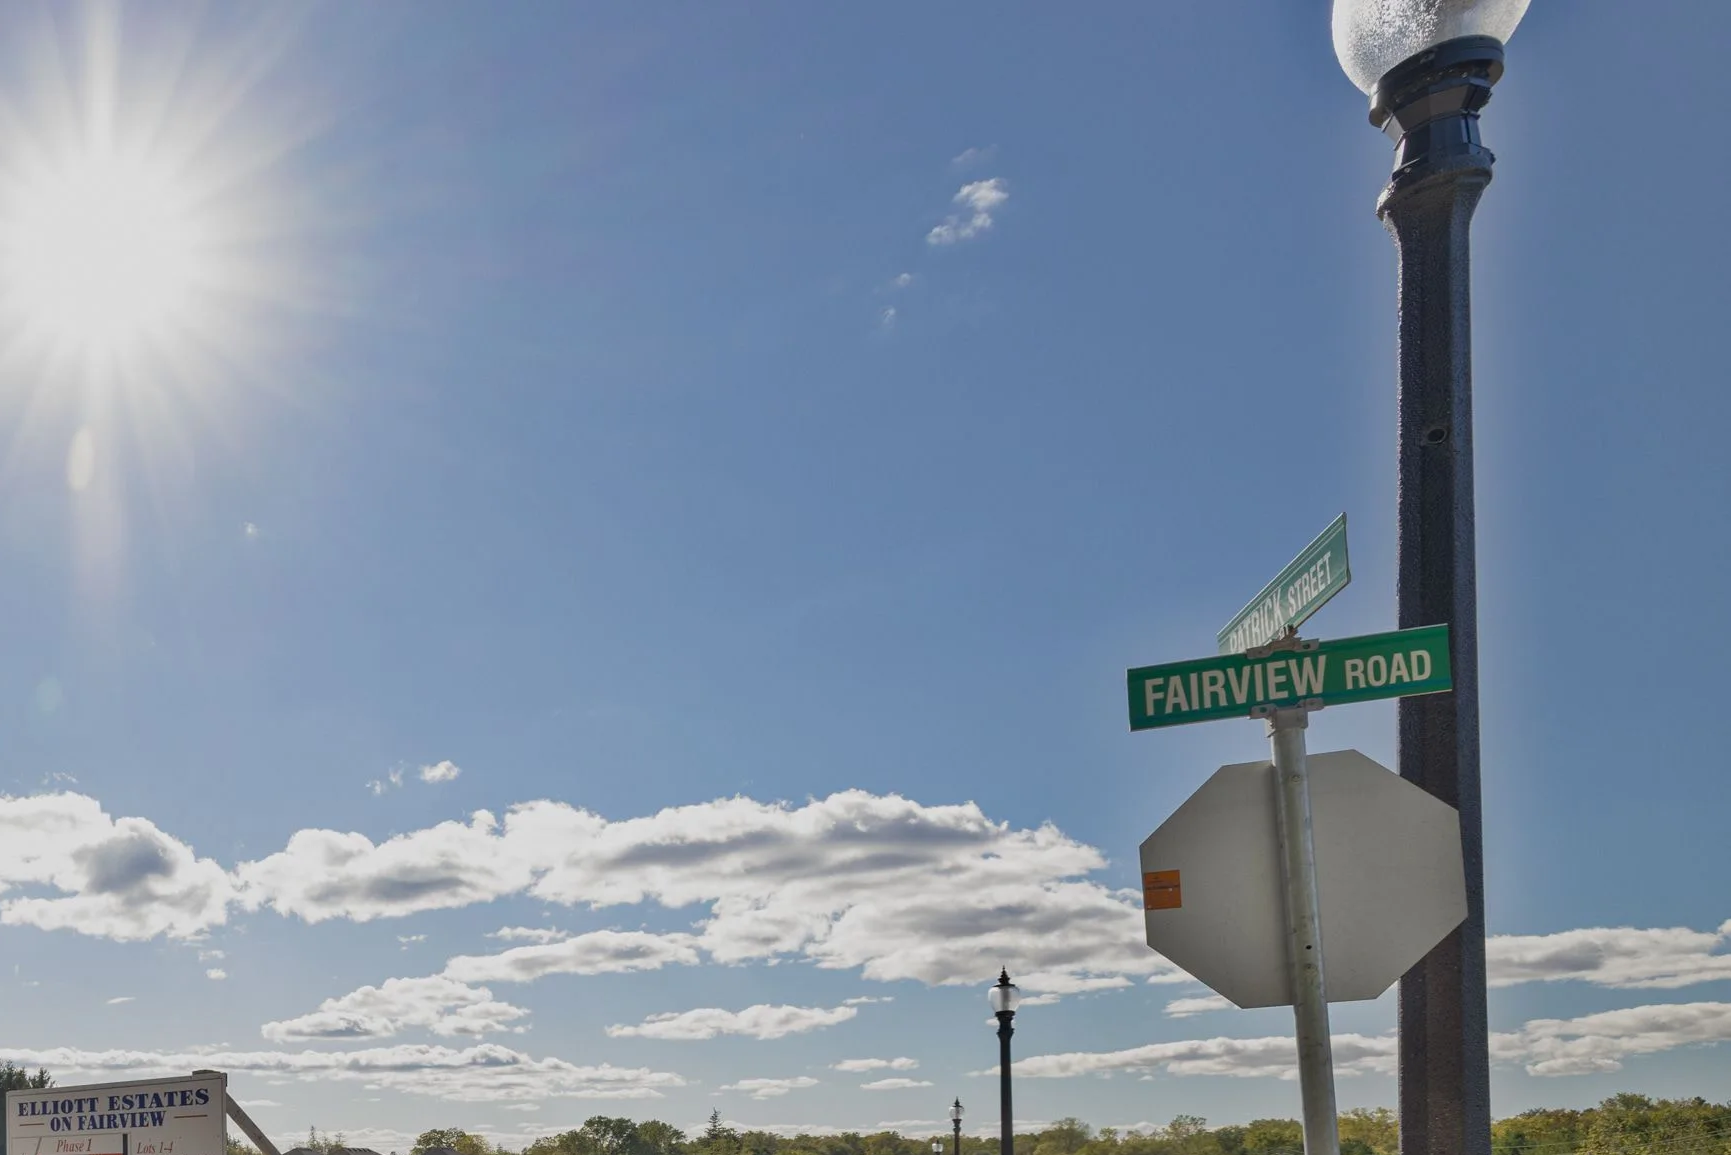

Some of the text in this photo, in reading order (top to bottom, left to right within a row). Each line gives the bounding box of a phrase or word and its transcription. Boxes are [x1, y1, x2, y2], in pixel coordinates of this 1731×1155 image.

[1229, 551, 1331, 655] PATRICK STREET
[1145, 650, 1432, 716] FAIRVIEW ROAD
[18, 1088, 210, 1117] ELLIOTT ESTATES
[50, 1111, 166, 1132] ON FAIRVIEW
[56, 1138, 93, 1152] Phase 1
[136, 1141, 174, 1154] Lots 1-4
